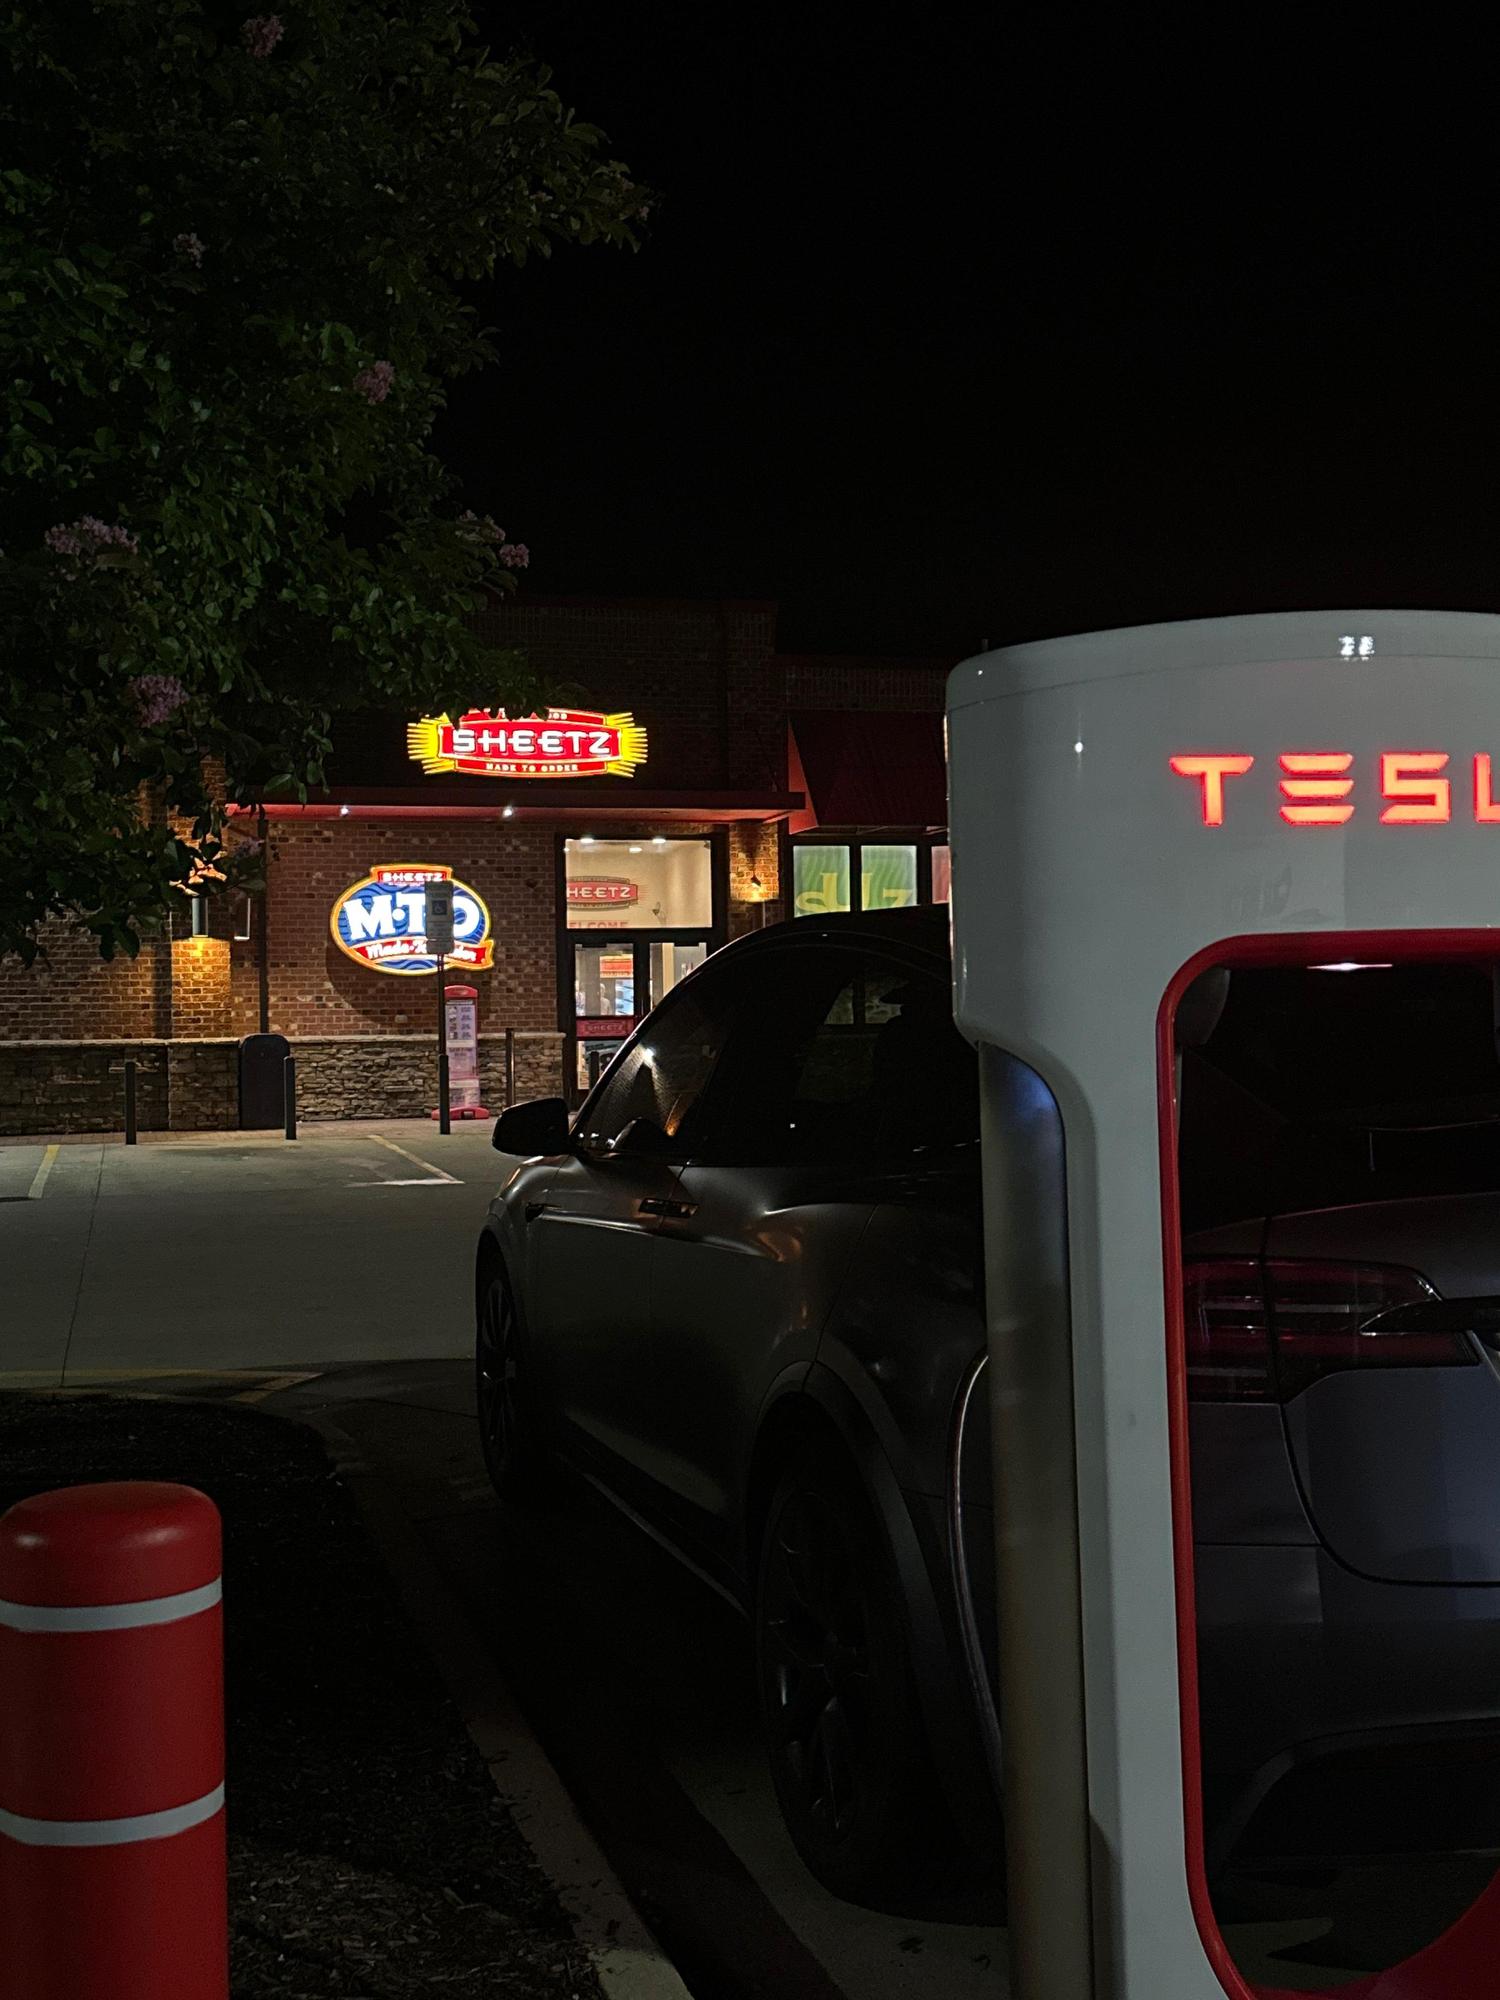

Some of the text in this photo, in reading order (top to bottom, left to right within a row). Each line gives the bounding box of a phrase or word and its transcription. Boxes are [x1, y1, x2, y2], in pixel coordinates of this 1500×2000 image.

[452, 728, 612, 756] SHEETZ
[486, 762, 578, 772] MADE TO ORDER
[383, 872, 443, 882] SHEETZ
[567, 886, 631, 899] HEETZ
